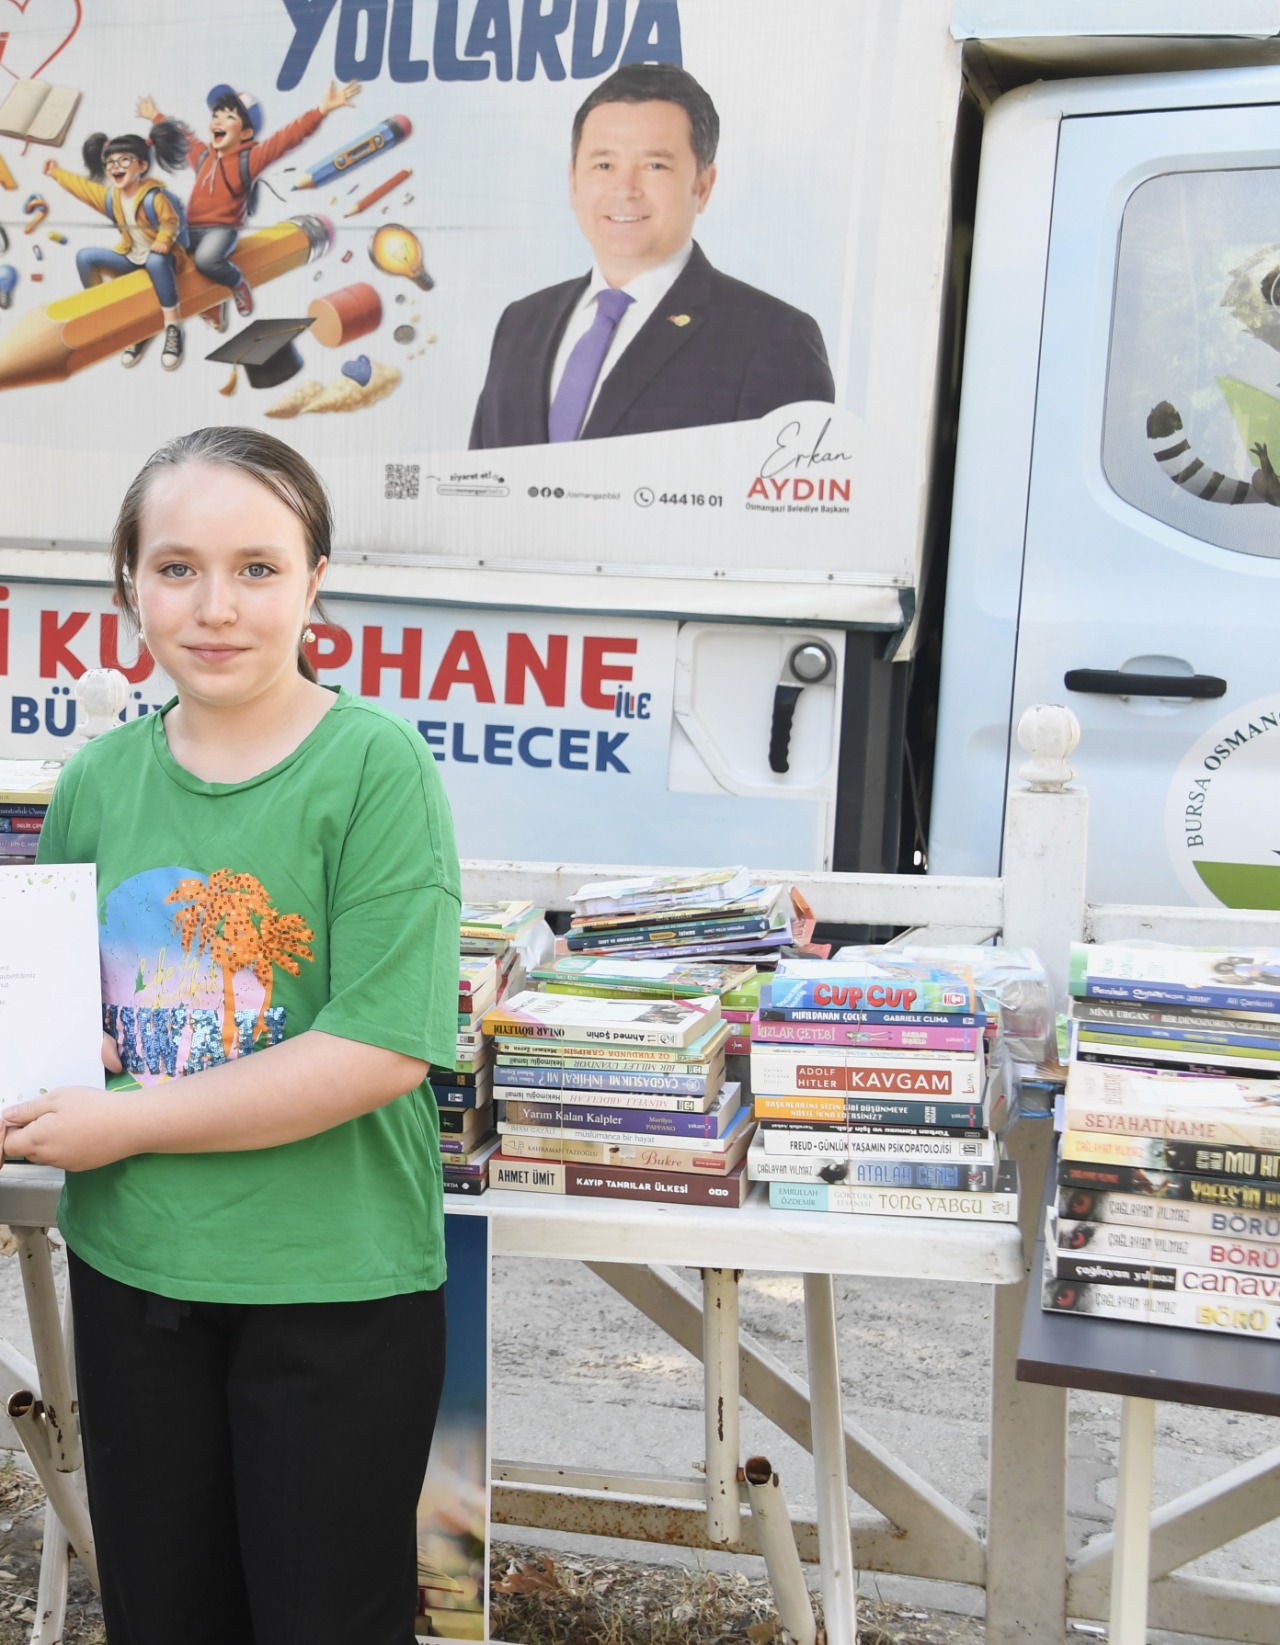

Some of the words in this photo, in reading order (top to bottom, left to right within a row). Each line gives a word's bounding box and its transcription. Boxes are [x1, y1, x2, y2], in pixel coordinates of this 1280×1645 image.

[276, 0, 682, 91] YOLLARDA
[760, 417, 852, 478] Erkan
[747, 477, 851, 502] AYDIN
[659, 493, 687, 506] 444
[691, 494, 705, 506] 16
[708, 495, 723, 507] 01
[745, 502, 785, 513] Osmangazi
[787, 505, 818, 513] Belediye
[821, 505, 849, 513] Başkanı
[406, 719, 630, 774] ELECEK
[1185, 776, 1211, 848] BURSA
[1204, 710, 1280, 771] OSMAN
[814, 983, 863, 1009] CUP
[867, 985, 918, 1010] CUP
[883, 1015, 921, 1023] GABRIELE
[1089, 1008, 1114, 1018] MİNA
[1117, 1010, 1150, 1020] URGAN
[536, 1027, 565, 1039] ONLAR
[587, 1031, 610, 1040] Şahin
[613, 1032, 645, 1041] Ahmed
[757, 1025, 794, 1039] KIZLAR
[607, 1050, 654, 1060] YURDUNDA
[574, 1060, 619, 1070] UYANIYOR
[623, 1062, 657, 1071] MİLLET
[799, 1067, 836, 1076] ADOLF
[798, 1079, 837, 1088] HITLER
[852, 1072, 949, 1091] KAVGAM
[525, 1092, 560, 1101] Hekimoğlu
[523, 1109, 552, 1119] Yarım
[555, 1111, 583, 1122] Kalan
[586, 1113, 623, 1126] Kalpler
[885, 1127, 917, 1135] Konusu
[919, 1128, 950, 1137] Türban
[1085, 1114, 1216, 1137] SEYAHATNAME
[623, 1132, 633, 1141] bir
[635, 1135, 655, 1144] hayat
[790, 1141, 812, 1151] FREUD
[818, 1140, 849, 1152] GÜNLÜK
[852, 1142, 886, 1153] YAŞAMIN
[888, 1142, 952, 1154] PSİKOPATOLOJİSİ
[641, 1151, 682, 1168] Bukre
[757, 1163, 787, 1175] ÇAĞLAYAN
[789, 1165, 813, 1175] YILMAZ
[857, 1164, 911, 1183] ATALAR
[917, 1166, 959, 1186] CENGİ
[498, 1169, 528, 1184] AHMET
[532, 1168, 556, 1186] ÜMİT
[576, 1178, 602, 1187] KAYIP
[605, 1180, 651, 1191] TANRILAR
[655, 1182, 688, 1194] ÜLKESİ
[779, 1188, 818, 1196] EMRULLAH
[781, 1197, 816, 1206] ÖZDEMİR
[878, 1194, 922, 1210] TONG
[927, 1197, 983, 1214] YABGU
[1212, 1213, 1280, 1237] BÖRÜ
[1210, 1244, 1279, 1268] BÖRÜ
[1075, 1265, 1130, 1280] çağlayan
[1183, 1271, 1280, 1297] canav
[1196, 1306, 1268, 1331] BÖRÜ
